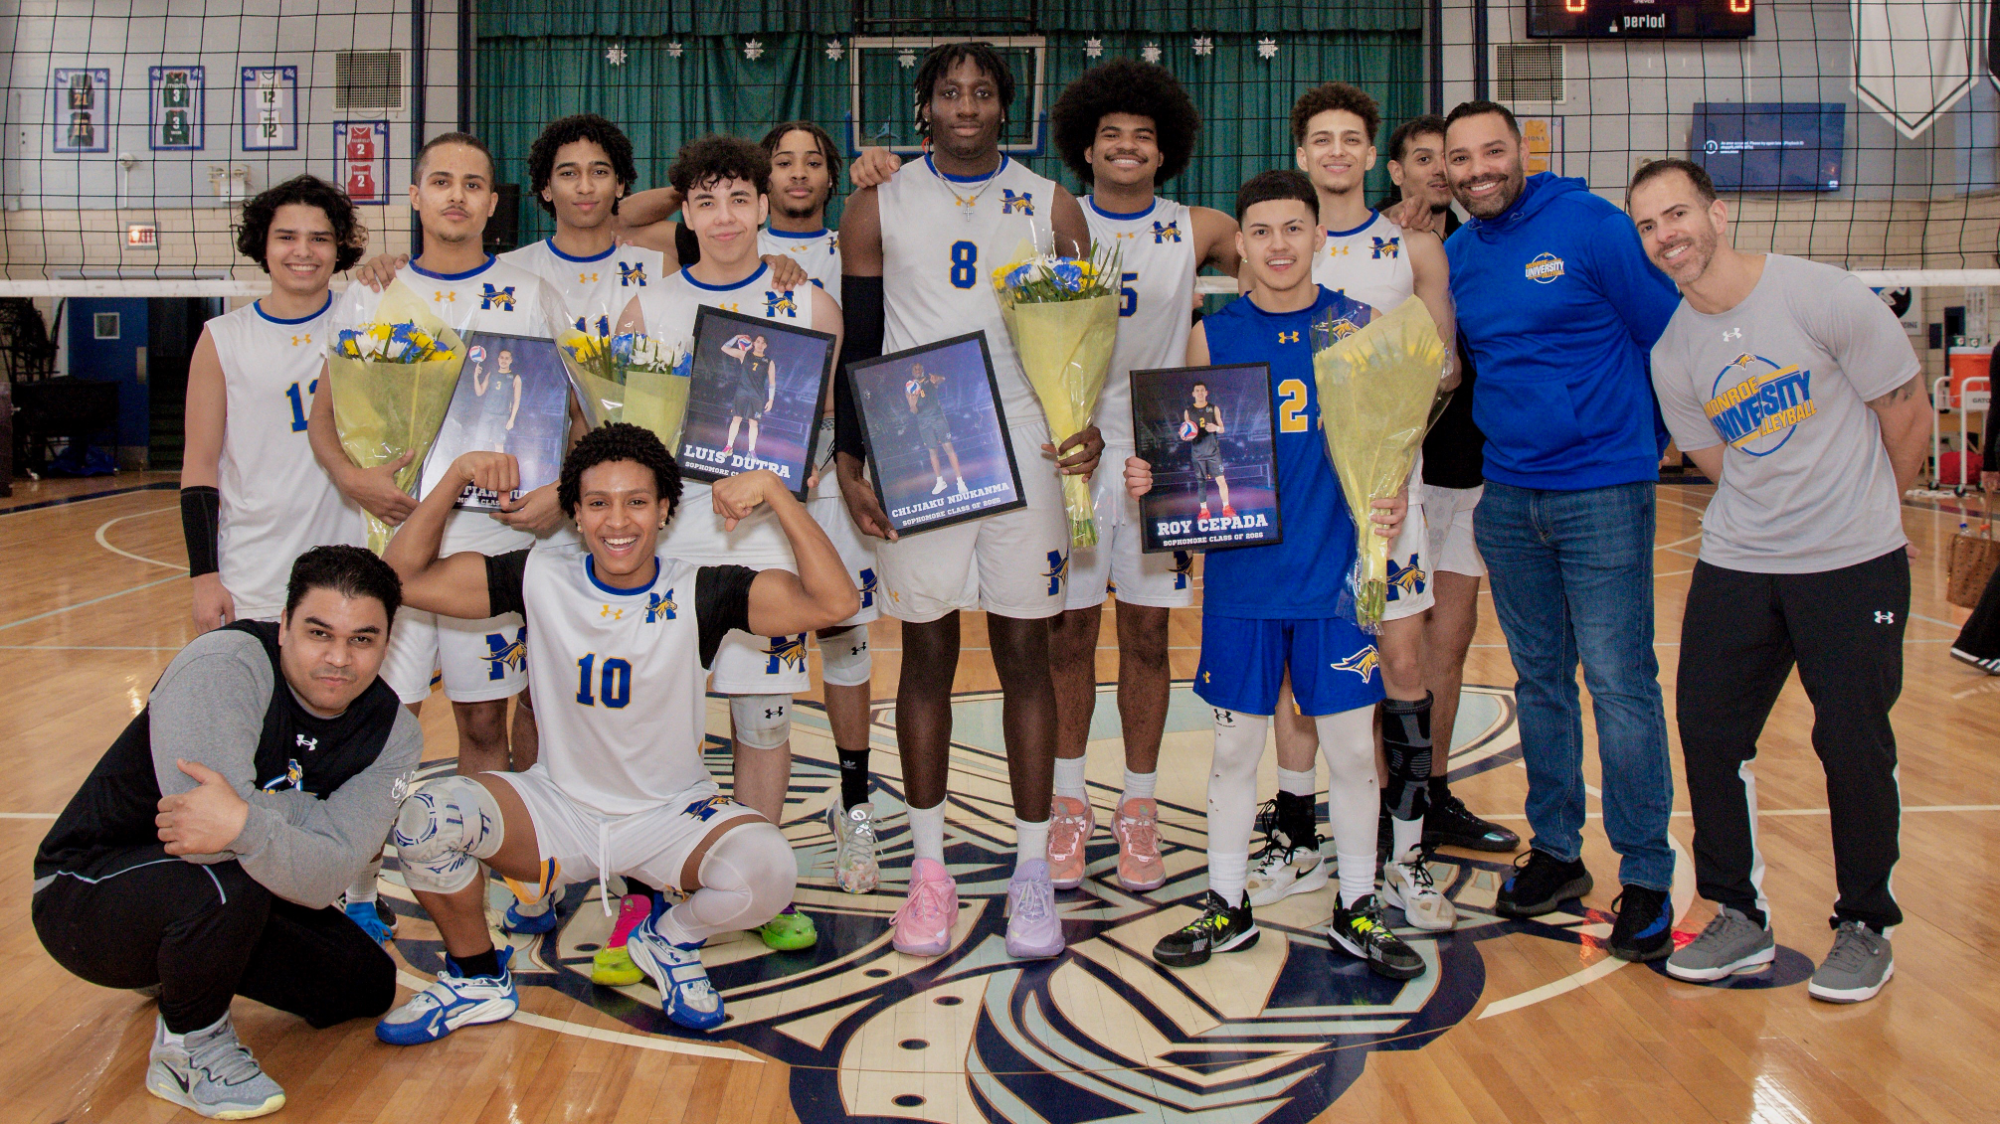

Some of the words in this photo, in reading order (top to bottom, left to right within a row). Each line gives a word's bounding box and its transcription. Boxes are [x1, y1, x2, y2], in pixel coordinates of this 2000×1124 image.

[1623, 13, 1666, 29] period
[173, 89, 181, 102] 3
[262, 91, 276, 103] 12
[173, 116, 180, 129] 3
[262, 123, 277, 138] 12
[356, 143, 365, 155] 2
[357, 175, 365, 187] 2
[949, 239, 979, 291] 8
[1525, 261, 1565, 277] UNIVERSITY
[284, 377, 319, 434] 1
[1277, 378, 1309, 434] 2
[1757, 398, 1818, 437] LLEYBALL
[683, 444, 727, 464] LUIS
[684, 461, 730, 476] SOPHOMORE
[731, 454, 791, 479] DUTRA
[463, 485, 498, 498] TIAN
[480, 498, 500, 506] CLAS
[891, 498, 945, 518] CHIJIAKU
[947, 482, 1010, 505] NDUKANMA
[902, 510, 946, 526] SOPHOMORE
[947, 504, 971, 515] CLASS
[971, 501, 981, 509] OF
[1157, 520, 1192, 536] ROY
[1197, 514, 1269, 532] CEPADA
[1163, 537, 1208, 546] SOPHOMORE
[1209, 534, 1232, 543] CLASS
[576, 651, 633, 709] 10
